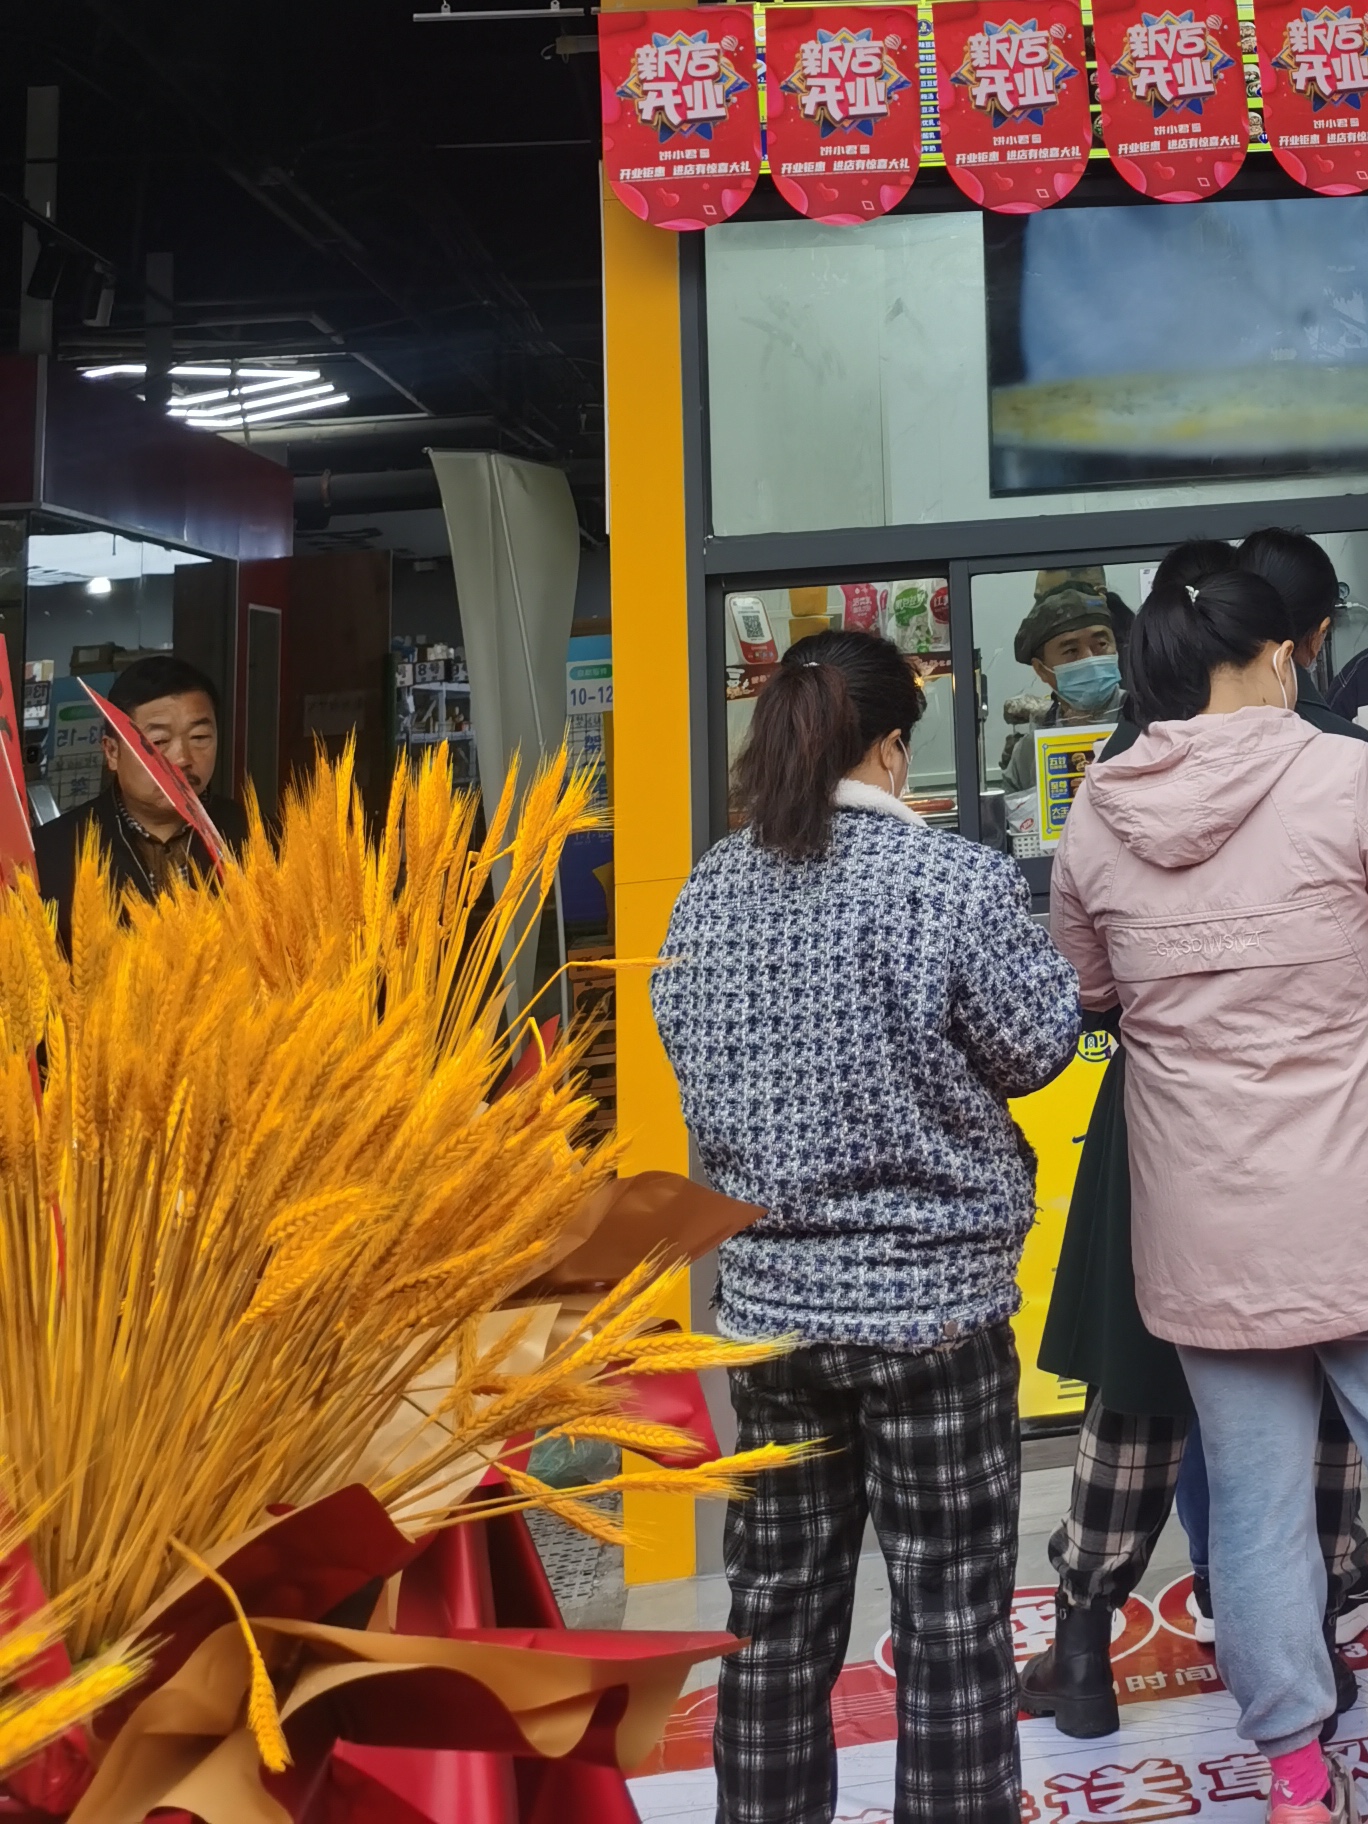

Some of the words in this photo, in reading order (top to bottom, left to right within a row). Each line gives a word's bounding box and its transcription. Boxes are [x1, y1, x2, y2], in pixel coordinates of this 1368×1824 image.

[968, 29, 1049, 70] 新店
[1128, 21, 1206, 58] 新店
[1288, 17, 1364, 53] 新店
[636, 39, 721, 80] 新店
[801, 38, 885, 78] 新店
[801, 77, 889, 122] 开业
[971, 68, 1057, 113] 开业
[1131, 58, 1216, 102] 开业
[637, 78, 727, 126] 开业
[570, 687, 613, 706] 10-12
[1113, 1664, 1218, 1694] 时间
